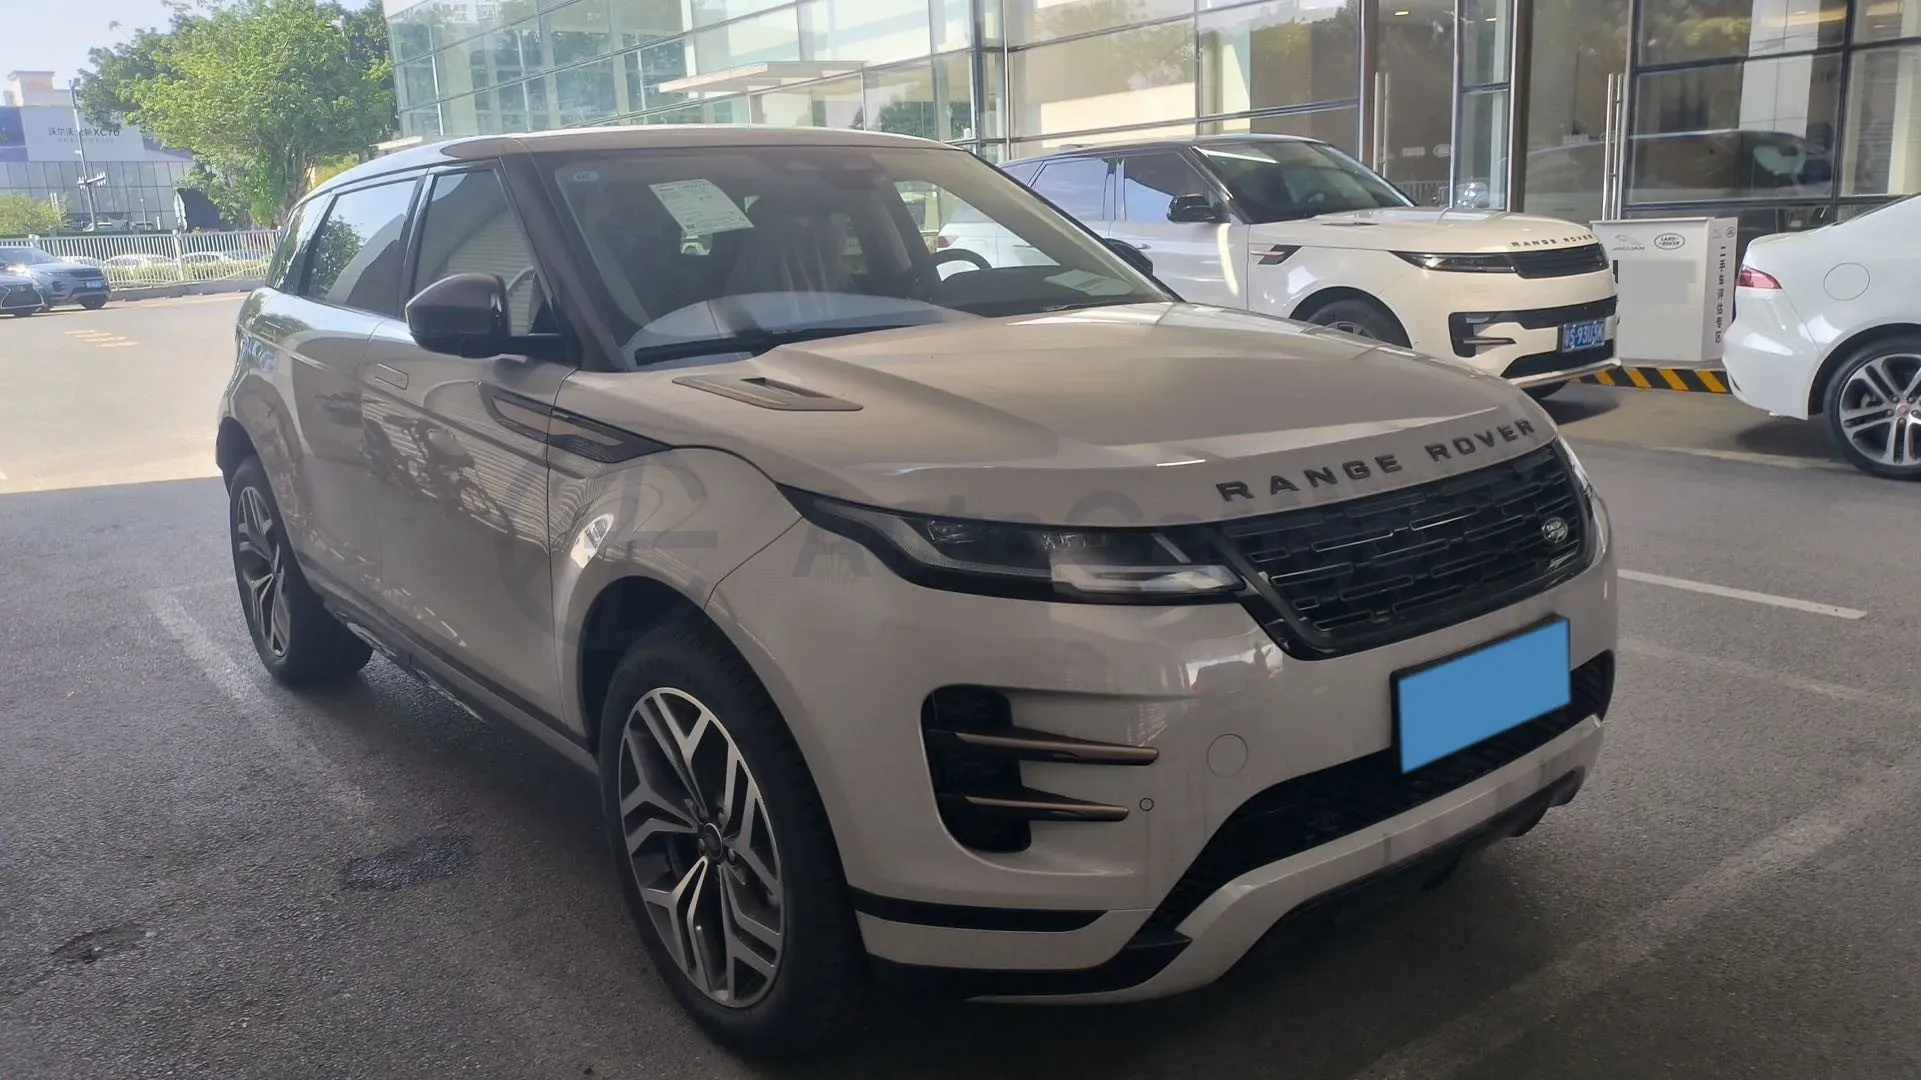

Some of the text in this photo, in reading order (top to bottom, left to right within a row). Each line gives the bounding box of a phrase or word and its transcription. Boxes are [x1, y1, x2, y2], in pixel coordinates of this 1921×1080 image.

[1511, 238, 1557, 247] RANGE
[1215, 418, 1536, 502] RANGE ROVER
